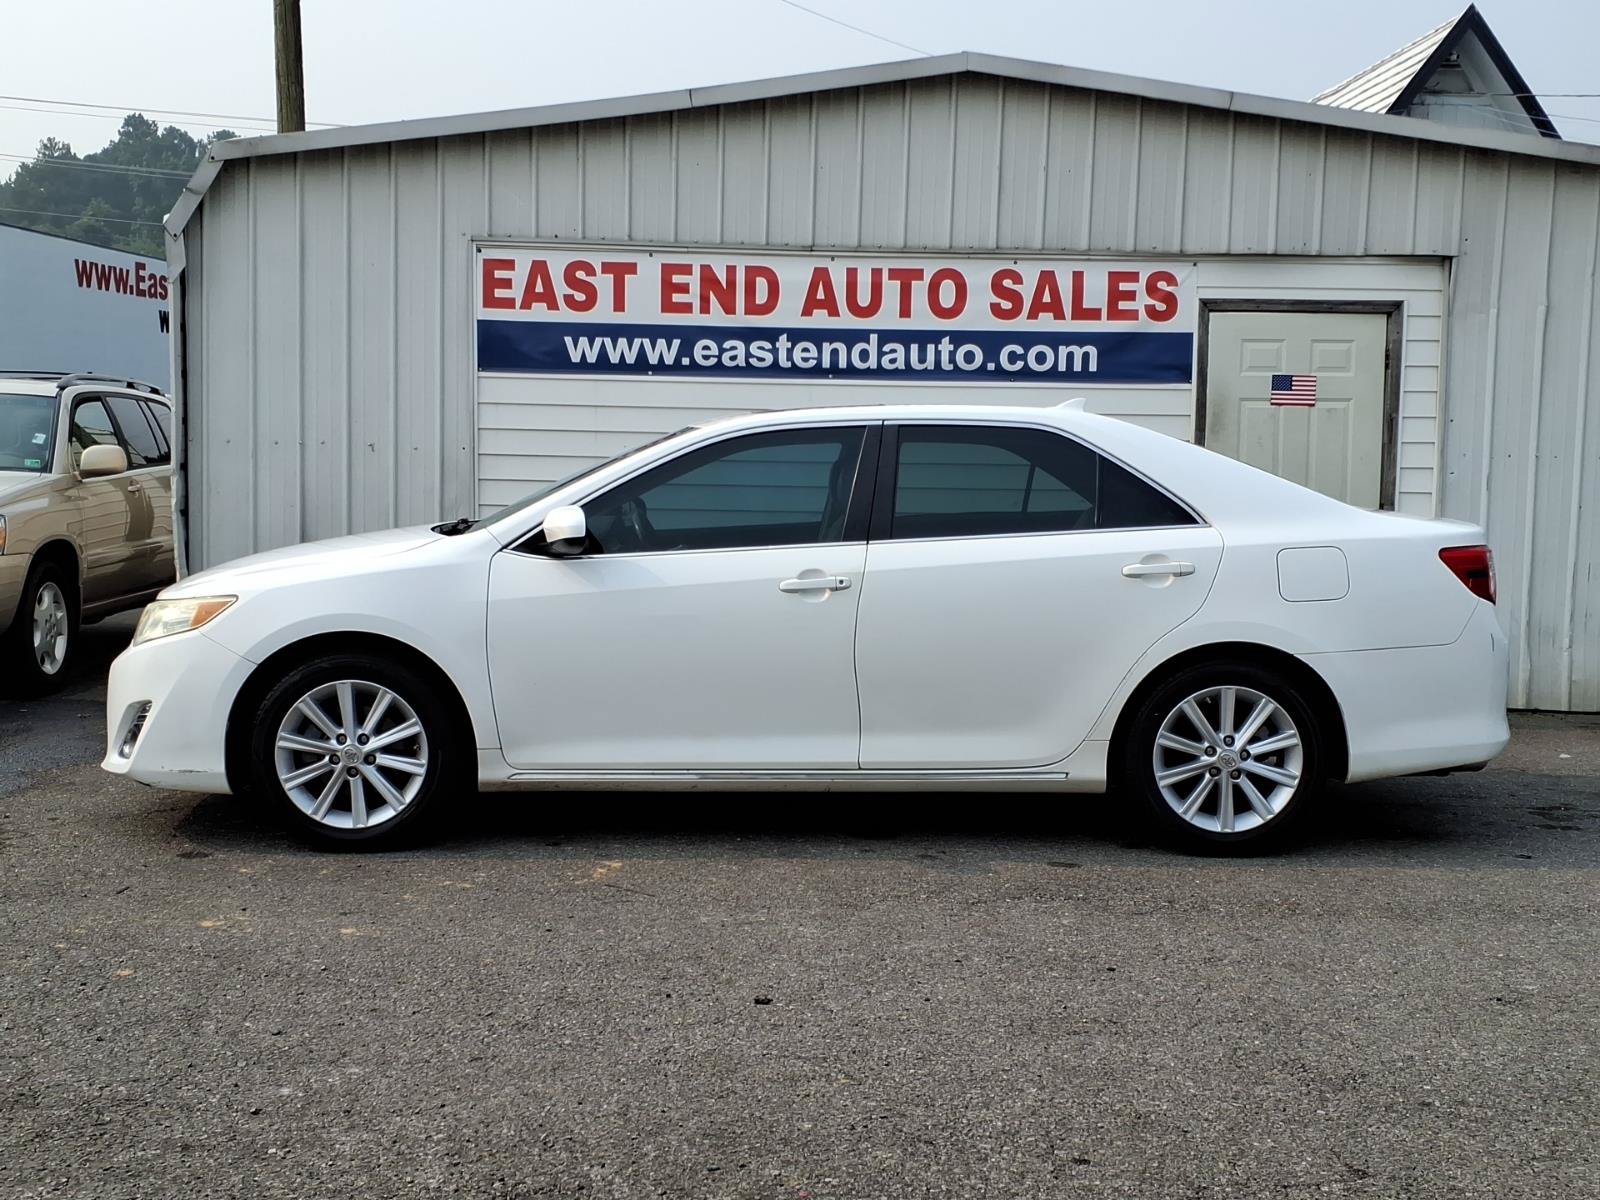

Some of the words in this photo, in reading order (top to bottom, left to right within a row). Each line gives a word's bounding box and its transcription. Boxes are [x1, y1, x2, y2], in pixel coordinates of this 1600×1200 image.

[483, 258, 637, 314] EAST
[661, 263, 780, 316] END
[802, 266, 968, 320] AUTO
[991, 269, 1179, 322] SALES
[563, 333, 1098, 373] www.eastendauto.com
